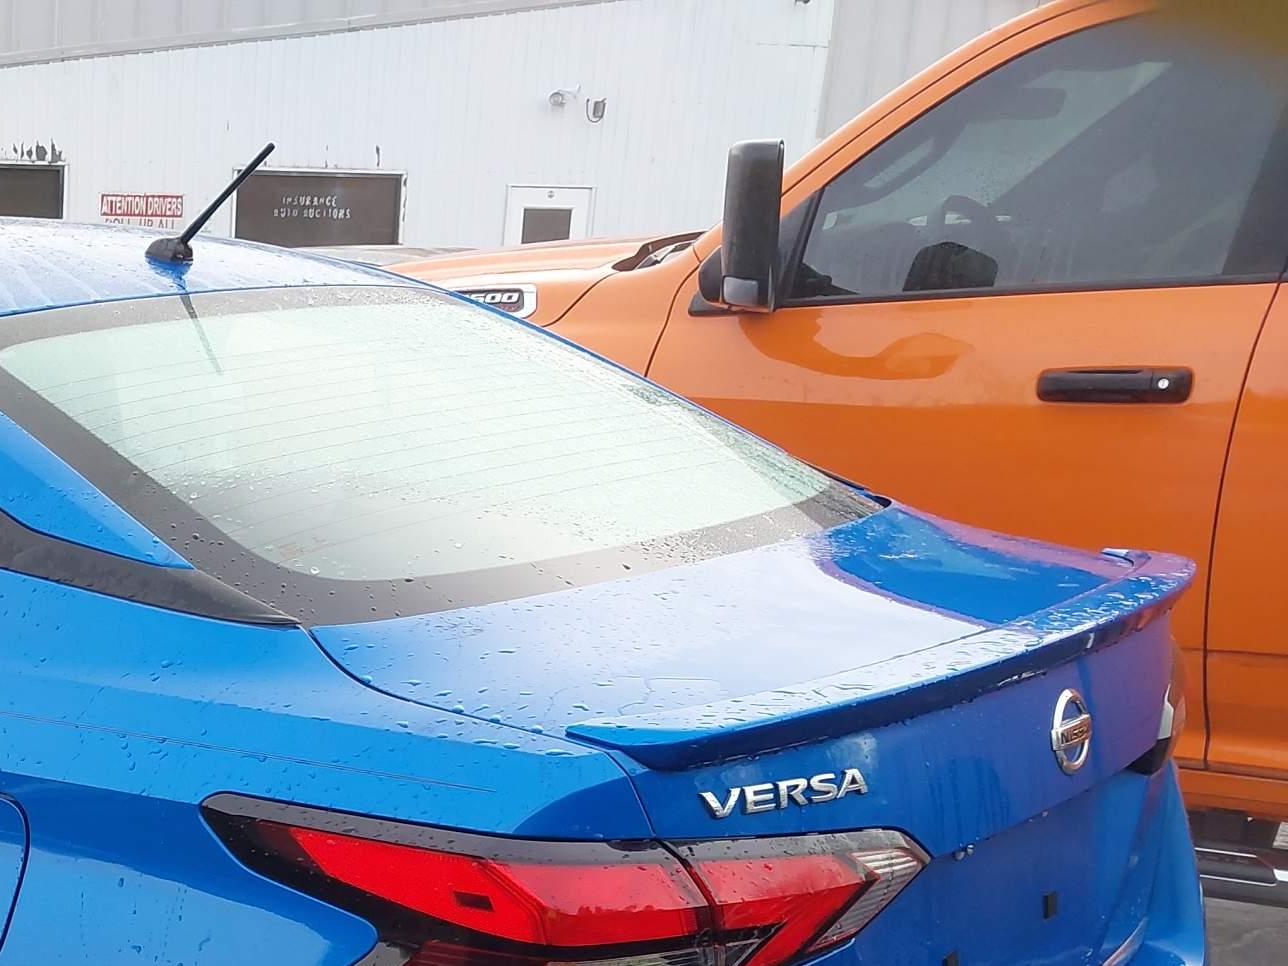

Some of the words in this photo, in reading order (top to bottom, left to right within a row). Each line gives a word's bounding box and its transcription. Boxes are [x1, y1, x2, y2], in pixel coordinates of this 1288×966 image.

[101, 196, 145, 215] ATTENTION
[147, 197, 182, 216] DRIVERS
[282, 196, 337, 207] INSURANCE
[467, 292, 520, 303] 500
[700, 768, 868, 817] VERSA
